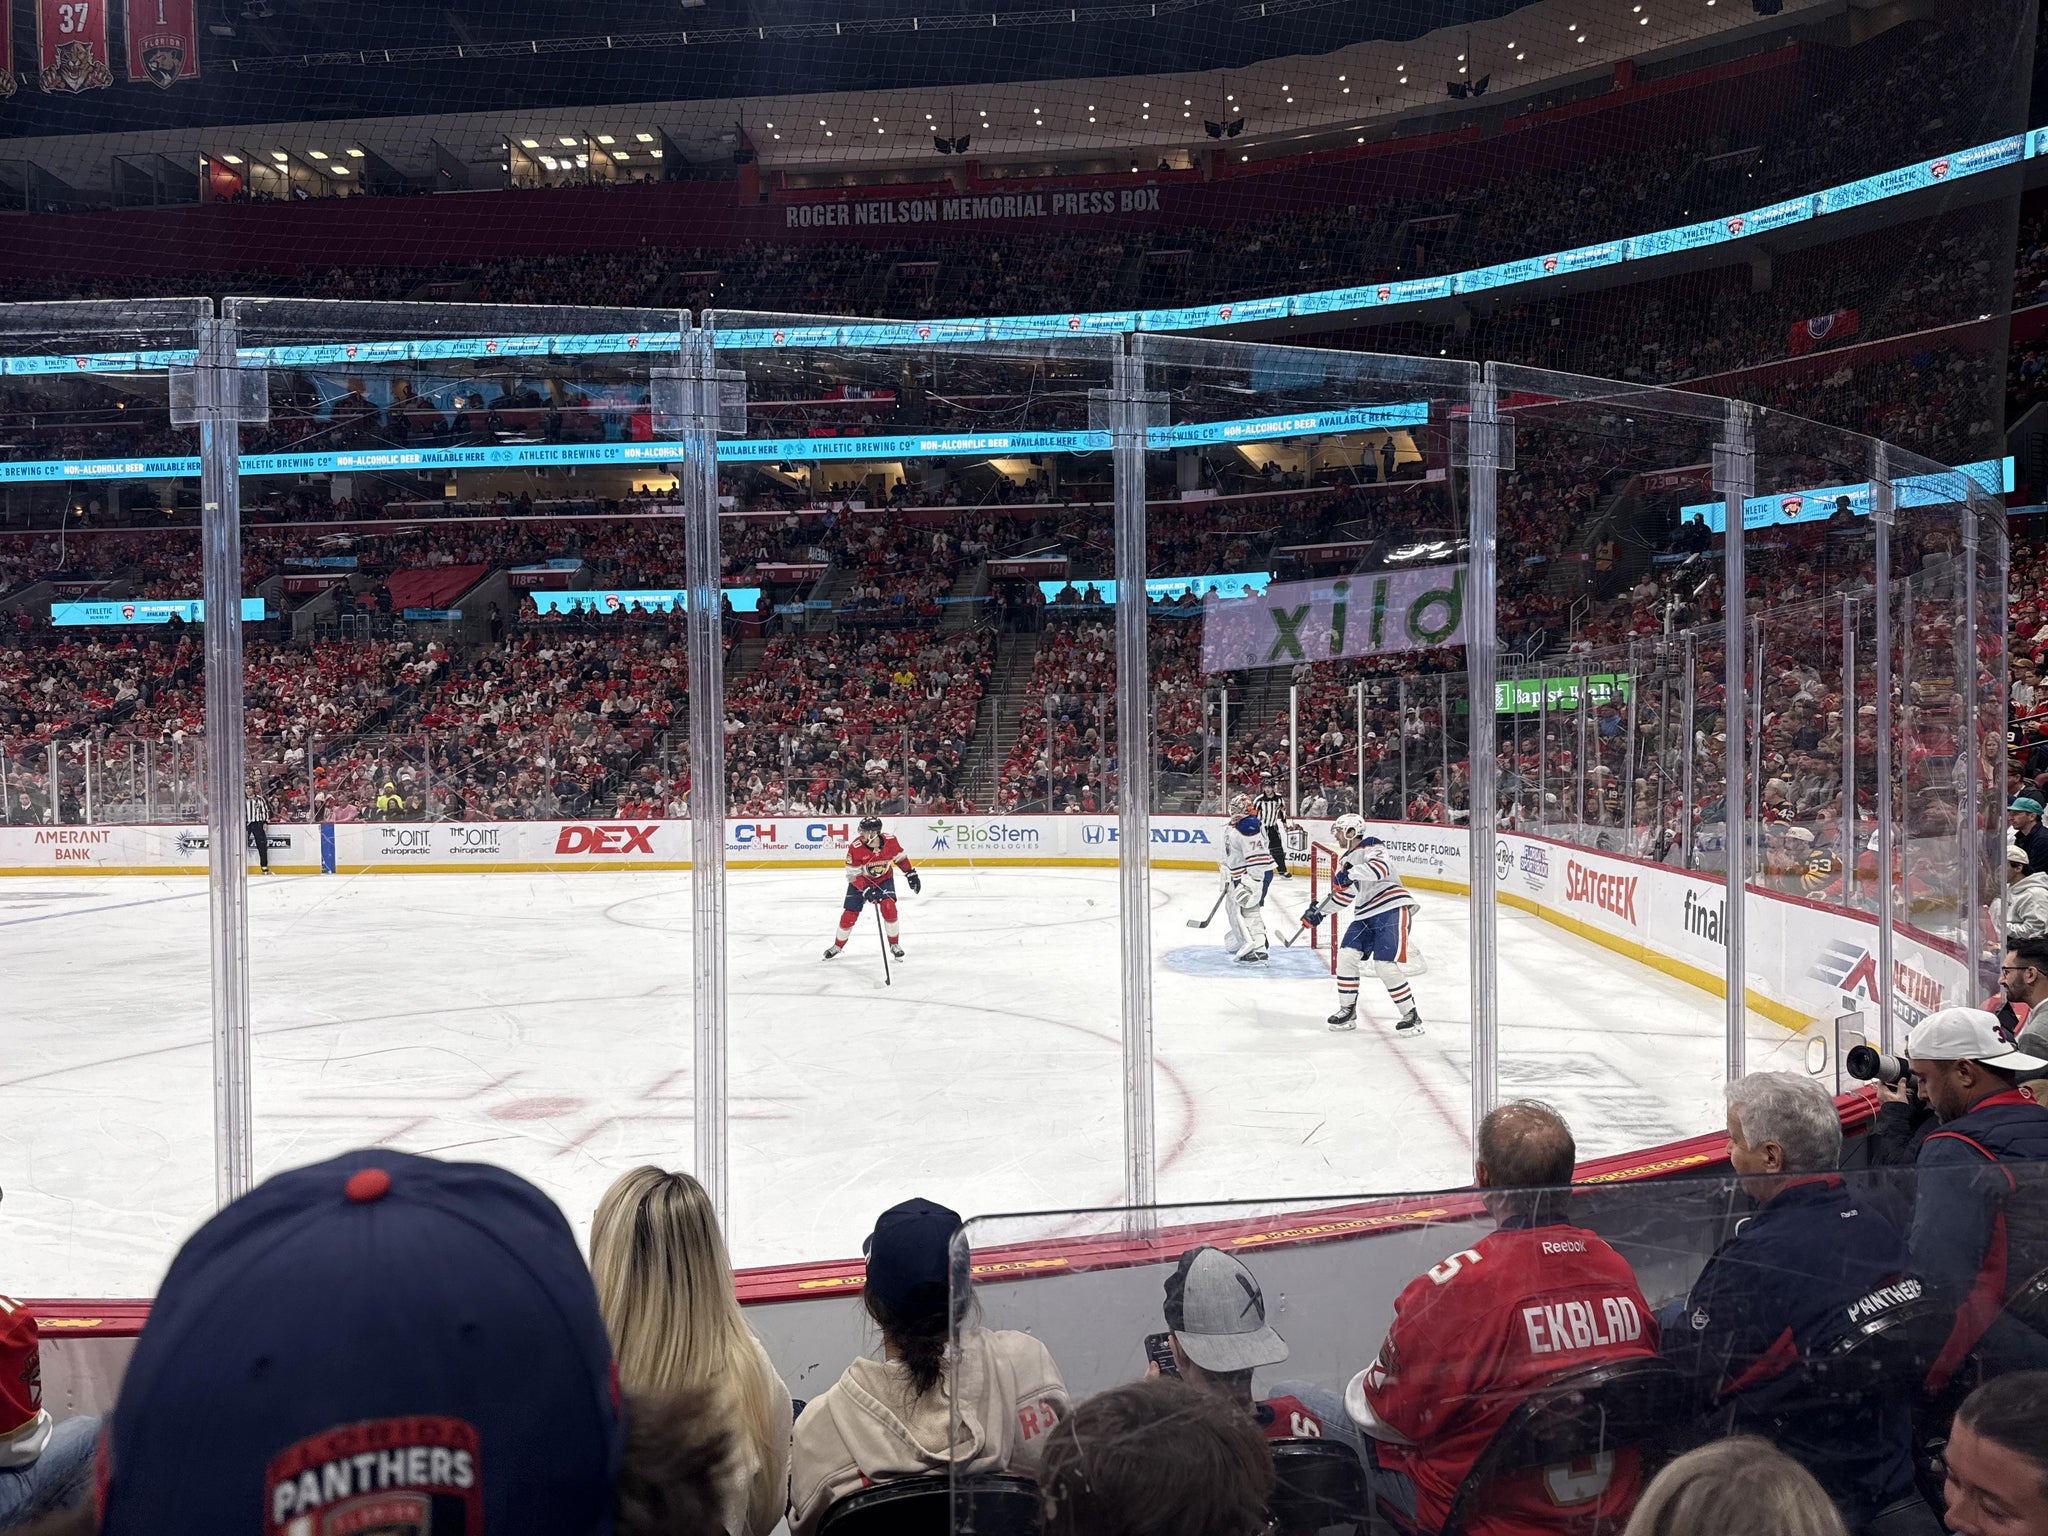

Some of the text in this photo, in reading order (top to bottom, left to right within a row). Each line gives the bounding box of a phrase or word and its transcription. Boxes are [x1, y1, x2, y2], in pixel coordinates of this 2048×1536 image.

[58, 2, 89, 33] 37
[1879, 171, 1916, 189] ATHLETIC
[786, 189, 1160, 228] ROGER NEILSON MEMORIAL PRESS BOX
[1682, 226, 1716, 240] ATHLETIC
[1503, 264, 1533, 276] ATHLETIC
[1339, 291, 1367, 301] ATHLETIC
[1184, 311, 1210, 320] ATHLETIC
[45, 359, 68, 367] ATHLETIC
[1223, 422, 1292, 437] NON-ALCOHOLIC
[1294, 419, 1317, 430] BEER
[1319, 413, 1367, 428] AVAILABLE
[1368, 411, 1392, 423] HERE
[717, 446, 756, 456] AVAILABLE
[758, 445, 778, 455] HERE
[812, 443, 852, 454] ATHLETIC
[856, 442, 896, 452] BREWING
[920, 439, 986, 451] NON-ALCOHOLIC
[988, 438, 1009, 448] BEER
[1010, 436, 1054, 447] AVAILABLE
[1056, 436, 1078, 446] HERE
[238, 459, 274, 470] ATHLETIC
[277, 458, 314, 468] BREWING
[337, 455, 399, 466] NON-ALCOHOLIC
[400, 454, 420, 464] BEER
[422, 453, 463, 463] AVAILABLE
[465, 452, 485, 462] HERE
[519, 450, 559, 461] ATHLETIC
[562, 449, 601, 459] BREWING
[5, 466, 41, 477] BREWING
[64, 464, 124, 475] NON-ALCOHOLIC
[125, 463, 144, 473] BEER
[146, 462, 185, 472] AVAILABLE
[187, 461, 201, 471] HER
[1745, 504, 1768, 515] HLETIC
[1823, 500, 1858, 511] AVALE
[991, 564, 1008, 575] 120
[289, 580, 302, 590] 117
[512, 575, 526, 585] 118
[85, 607, 113, 615] ATHLETIC
[1512, 685, 1564, 706] Bapst
[1778, 808, 1795, 822] 42
[35, 830, 111, 844] AMERANT
[381, 828, 395, 838] THE
[449, 827, 464, 838] THE
[735, 824, 776, 843] CH
[806, 823, 849, 842] CH
[957, 824, 1039, 843] BioStem
[1108, 827, 1211, 844] HNDA
[187, 839, 204, 848] Air
[555, 825, 662, 855] DEX
[763, 842, 789, 851] Hunter
[794, 842, 822, 852] Cooper
[835, 842, 849, 850] Hun
[1250, 841, 1264, 851] 74
[55, 848, 91, 861] BANK
[381, 846, 431, 855] chiropractic
[449, 846, 500, 855] chiropractic
[1418, 843, 1430, 854] OF
[1430, 844, 1461, 858] FLORIDA
[1406, 855, 1429, 865] Autism
[1429, 856, 1444, 867] Care
[1808, 858, 1833, 874] 63
[1566, 859, 1639, 926] SEATGEEK
[1684, 889, 1727, 947] final
[1894, 959, 1945, 1013] ACTION
[1265, 1214, 1415, 1240] DO NOT LEAN ON GLASS
[1542, 1239, 1587, 1255] Reebok
[979, 1263, 1027, 1272] GLASS
[1427, 1249, 1483, 1286] 5
[841, 1277, 866, 1285] DO
[1522, 1296, 1642, 1355] EKBLAD
[273, 1446, 474, 1525] PANTHERS
